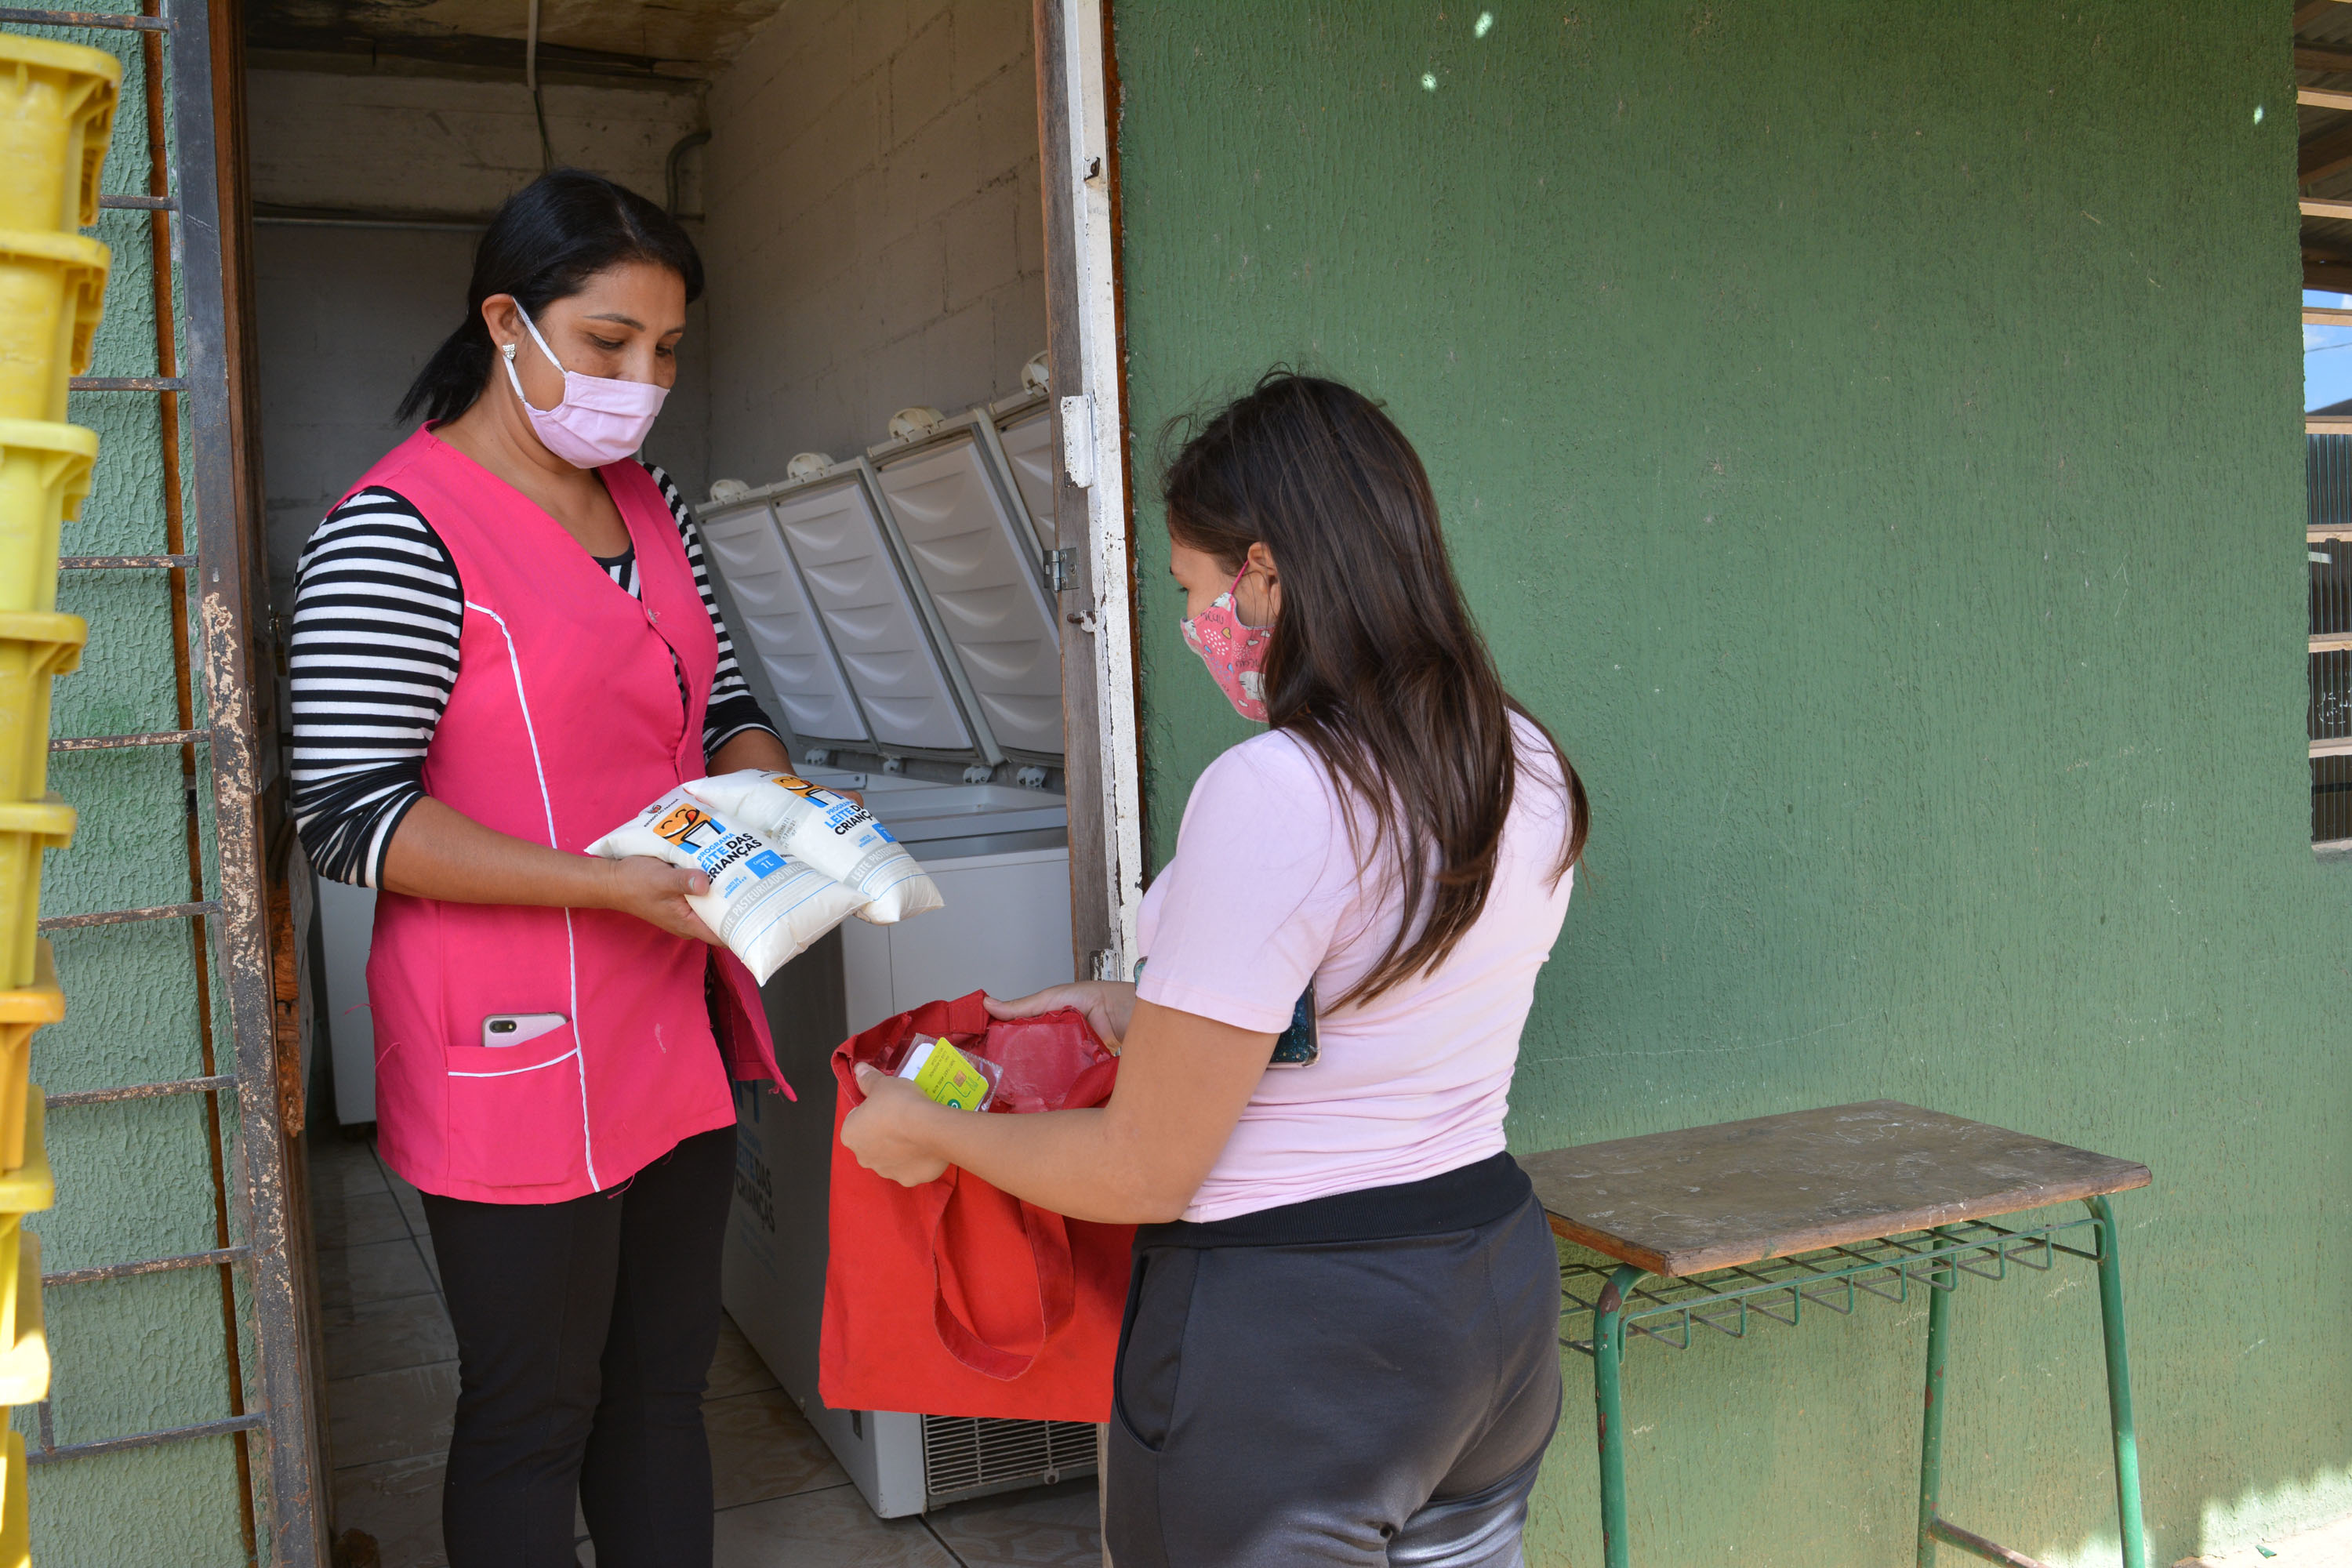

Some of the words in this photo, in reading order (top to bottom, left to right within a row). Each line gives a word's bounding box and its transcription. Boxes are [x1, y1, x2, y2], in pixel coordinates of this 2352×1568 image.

[824, 808, 855, 829] LEITE
[834, 811, 873, 835] CRIANÇ
[696, 833, 735, 862] PROGRAMA
[701, 846, 729, 873] EITE
[725, 833, 753, 850] DAS
[851, 861, 872, 882] LEITE
[722, 915, 734, 938] LEITE
[732, 873, 784, 916] PASTEURIZADO
